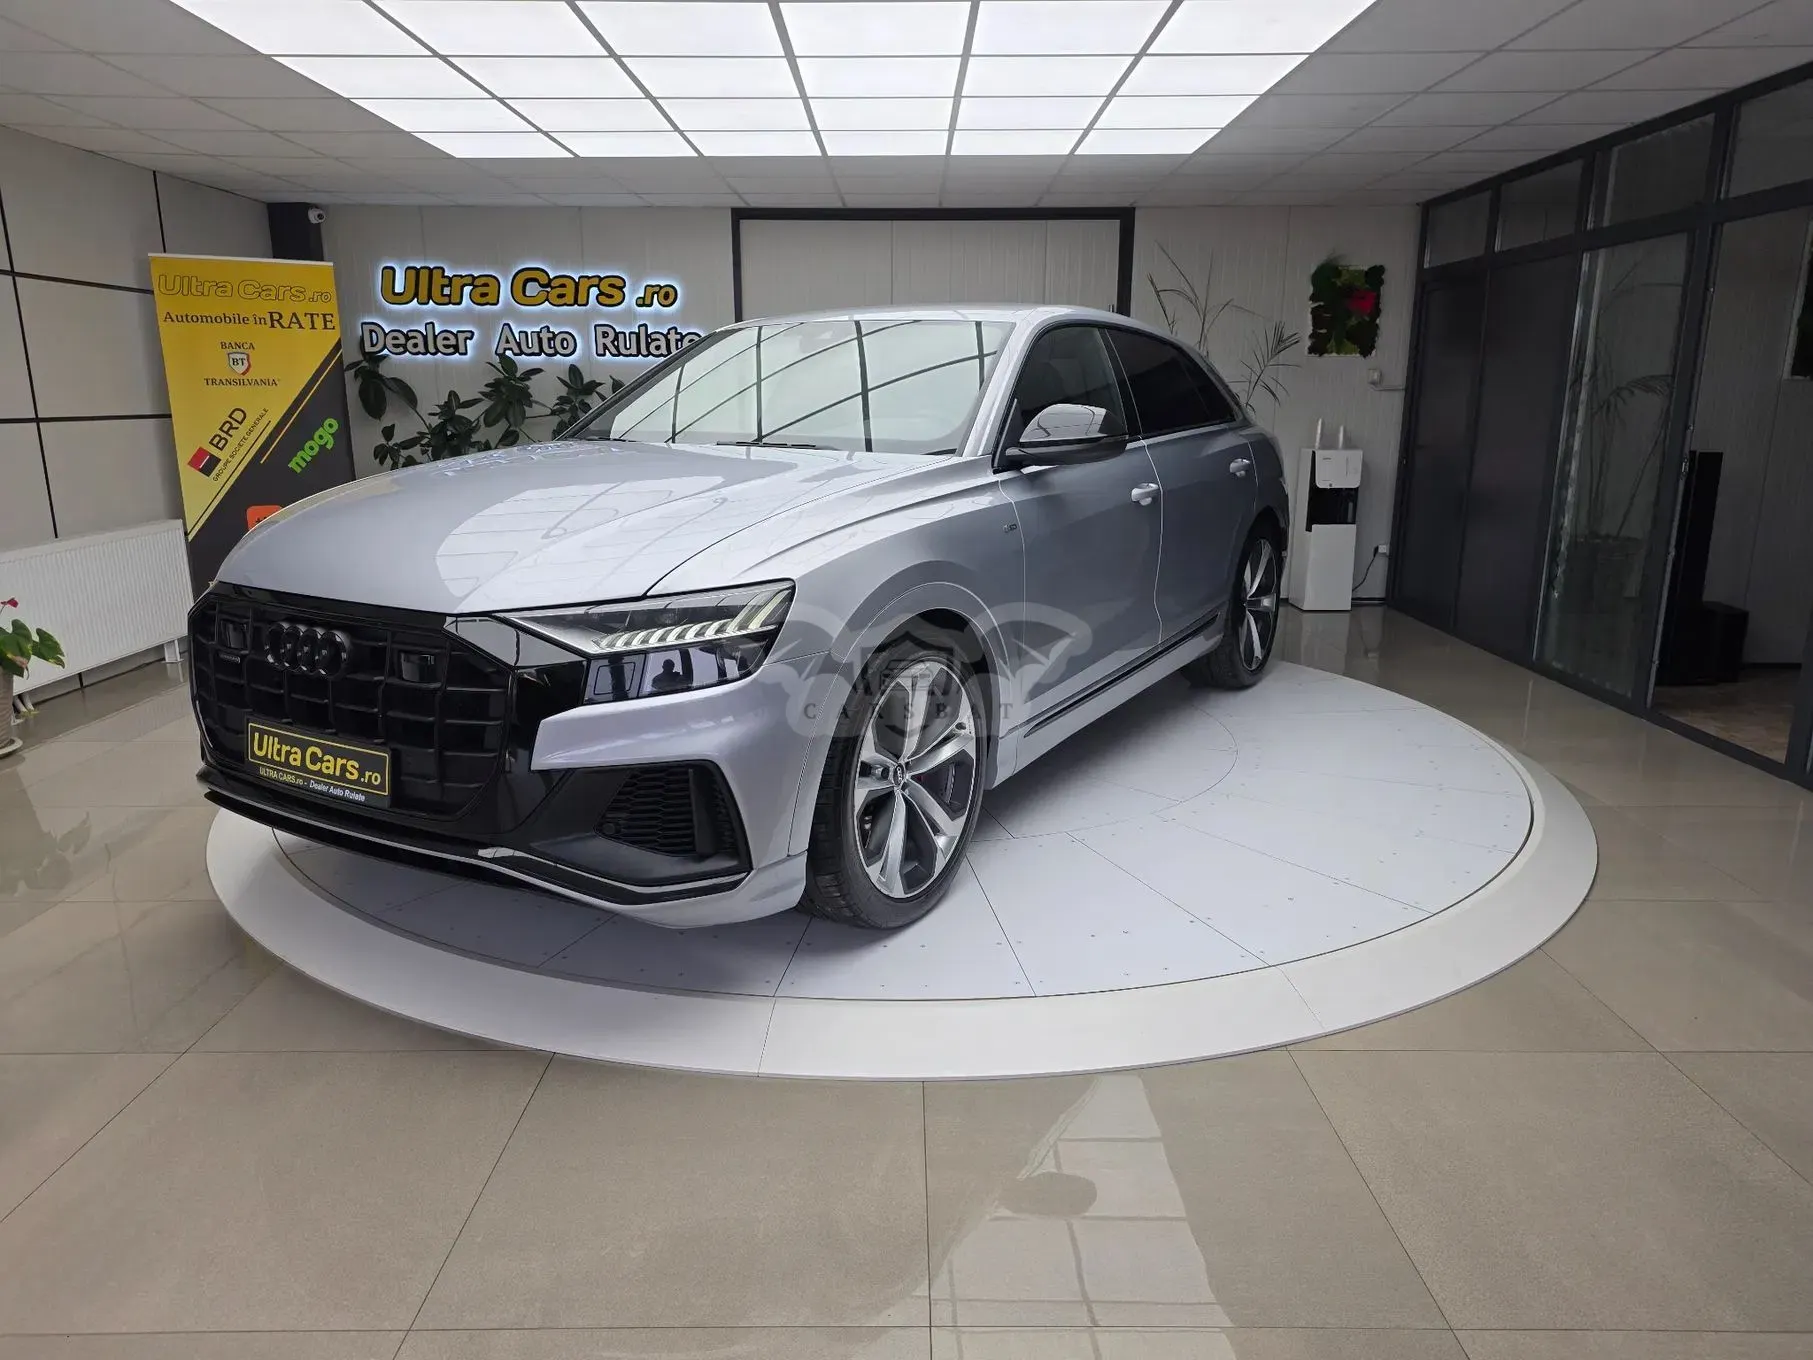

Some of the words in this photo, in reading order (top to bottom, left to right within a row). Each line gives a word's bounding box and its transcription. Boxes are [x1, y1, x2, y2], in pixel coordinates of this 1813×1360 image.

[158, 274, 234, 298] Ultra
[237, 279, 306, 302] Cars
[381, 266, 501, 306] Ultra
[511, 267, 627, 307] Cars
[163, 311, 250, 325] Automobile
[268, 311, 336, 330] RATE
[220, 341, 256, 351] BANCA
[361, 322, 475, 356] Dealer
[496, 323, 578, 357] Auto
[231, 357, 246, 367] BT
[203, 377, 278, 387] TRANSILVANIA
[208, 407, 247, 451] BRD
[288, 418, 339, 474] mogo
[253, 732, 302, 767] Ultra
[259, 766, 278, 780] ULTRA
[309, 780, 329, 793] Dealer
[328, 786, 344, 797] Auto
